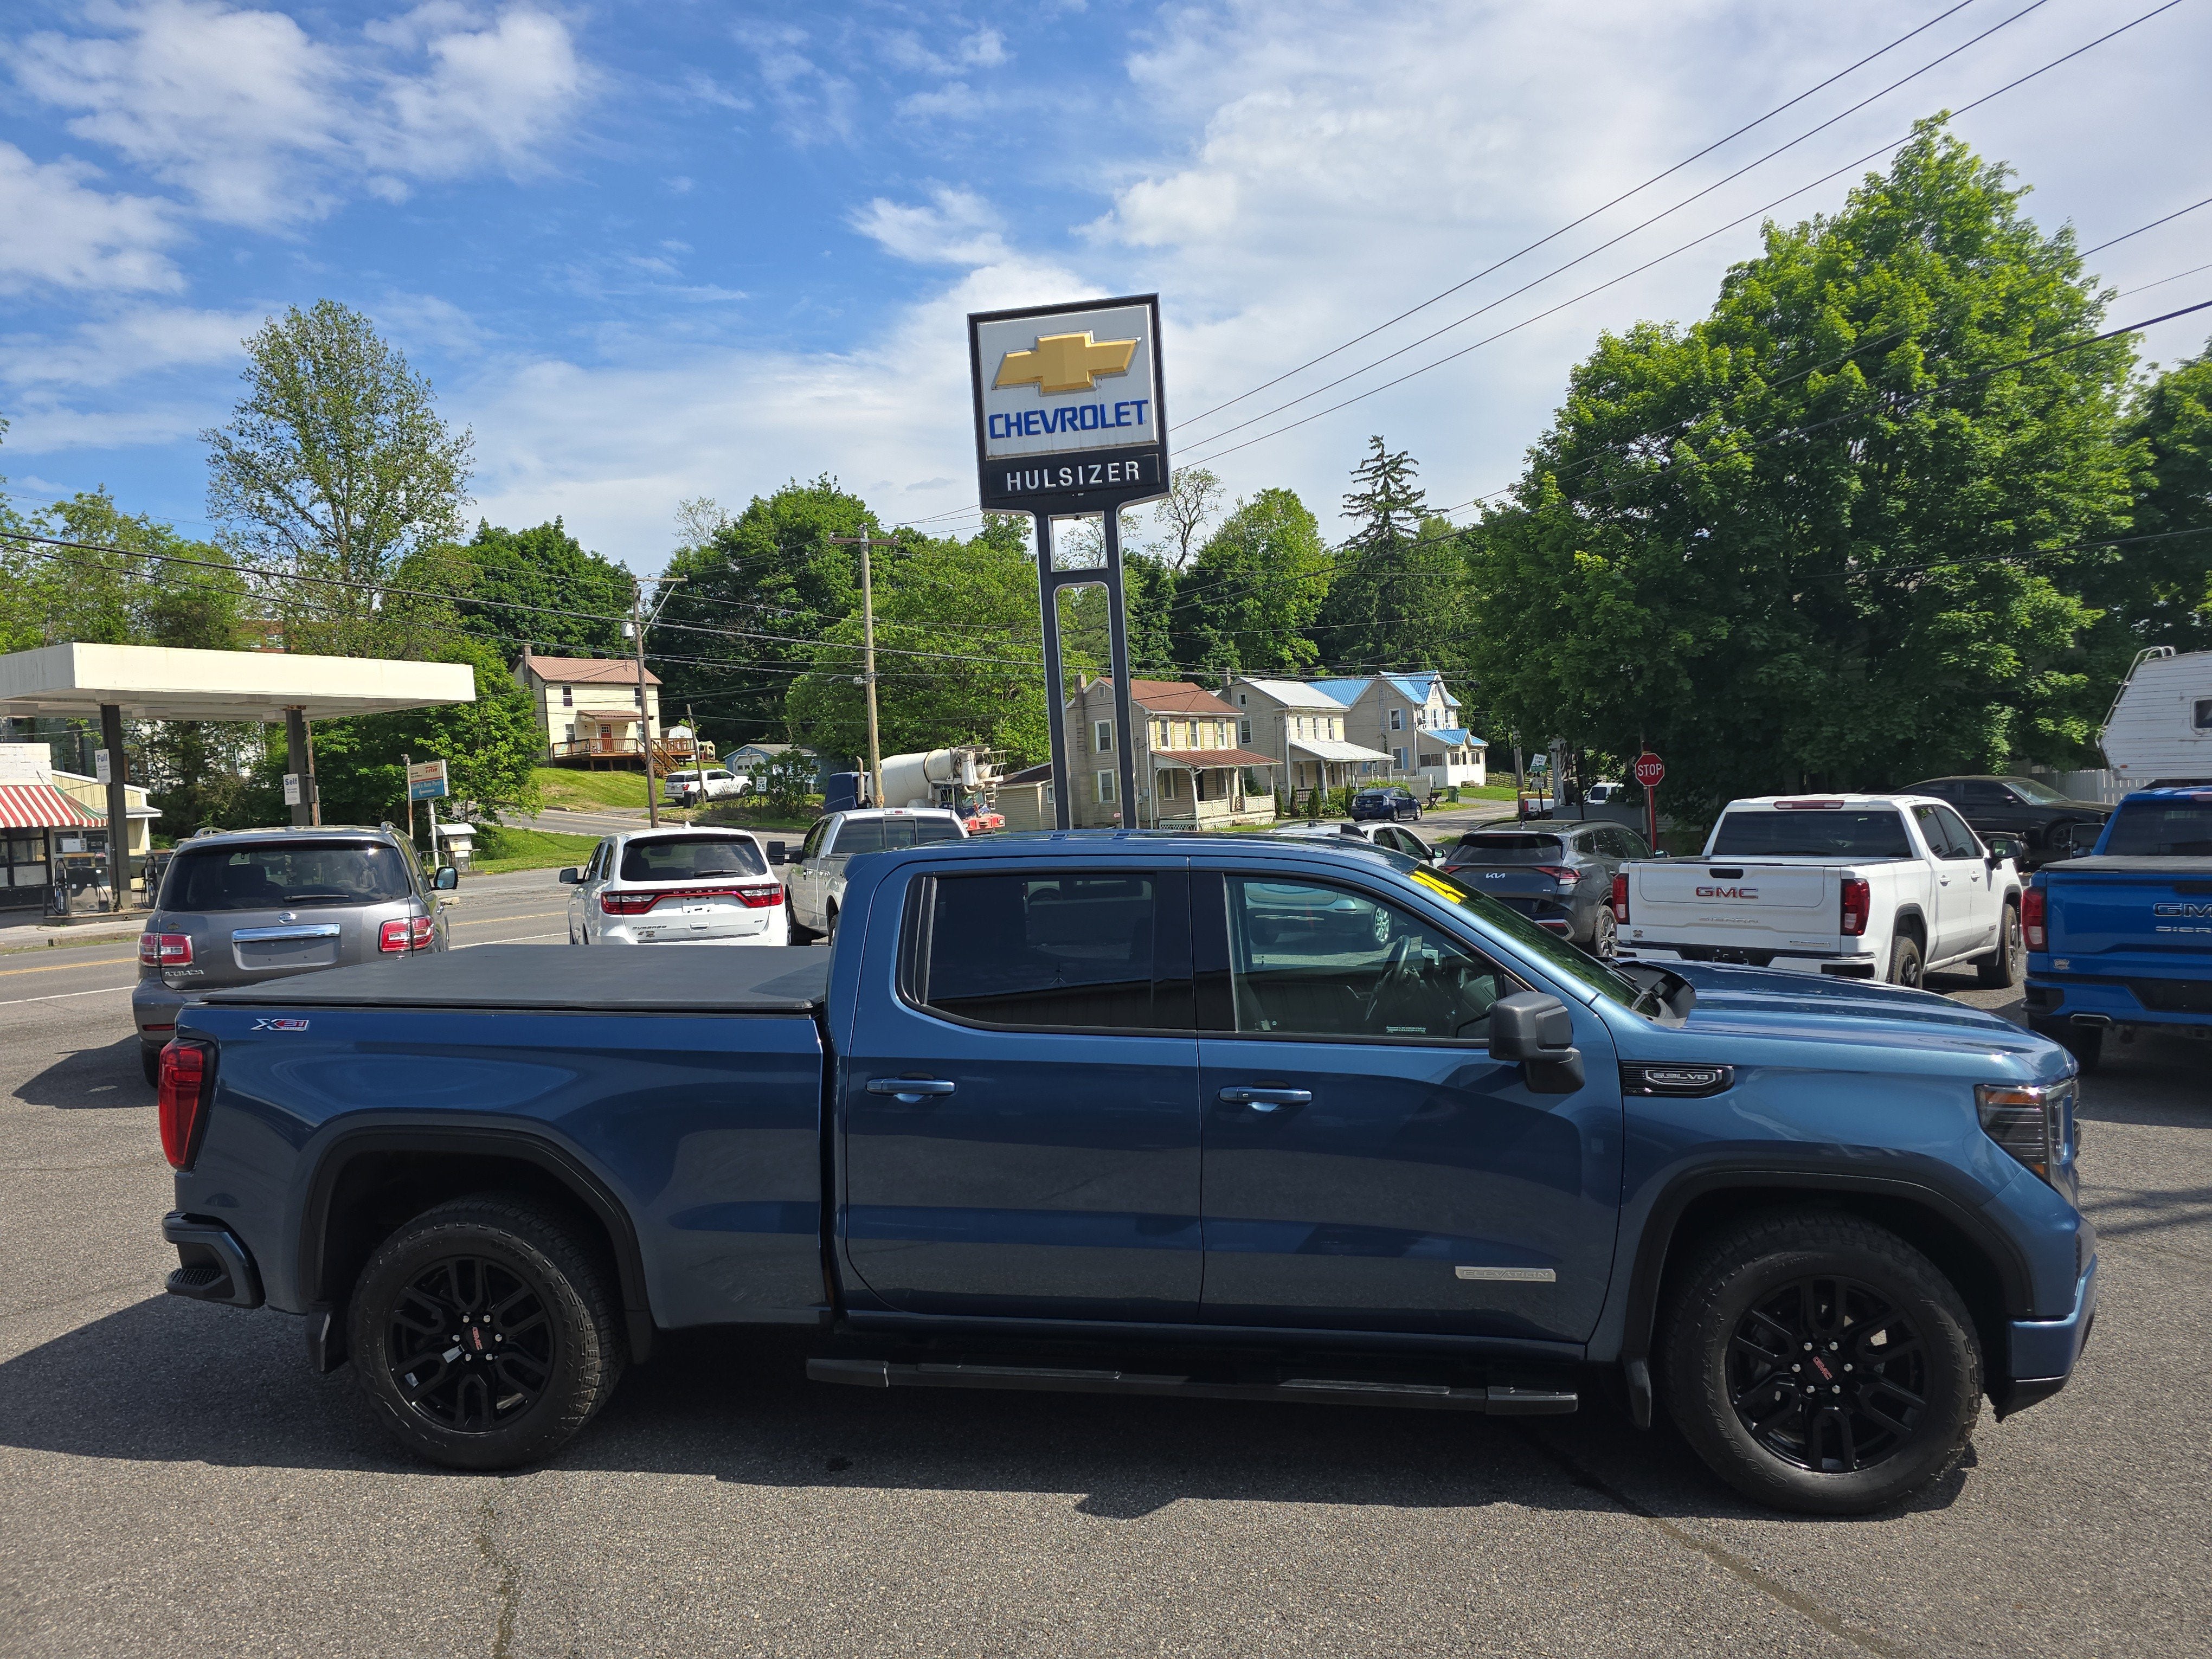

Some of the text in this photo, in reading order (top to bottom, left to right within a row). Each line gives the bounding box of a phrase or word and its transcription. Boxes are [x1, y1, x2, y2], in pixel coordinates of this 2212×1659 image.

[988, 400, 1148, 439] CHEVROLET
[1007, 461, 1139, 492] HULSIZER
[97, 754, 107, 762] Full
[1638, 763, 1662, 776] STOP
[285, 777, 297, 786] Self
[1696, 886, 1758, 899] GMC
[250, 1019, 307, 1030] X31
[1464, 1270, 1548, 1278] ELEVATION
[472, 1327, 483, 1351] GMC
[1812, 1356, 1833, 1380] GMC
